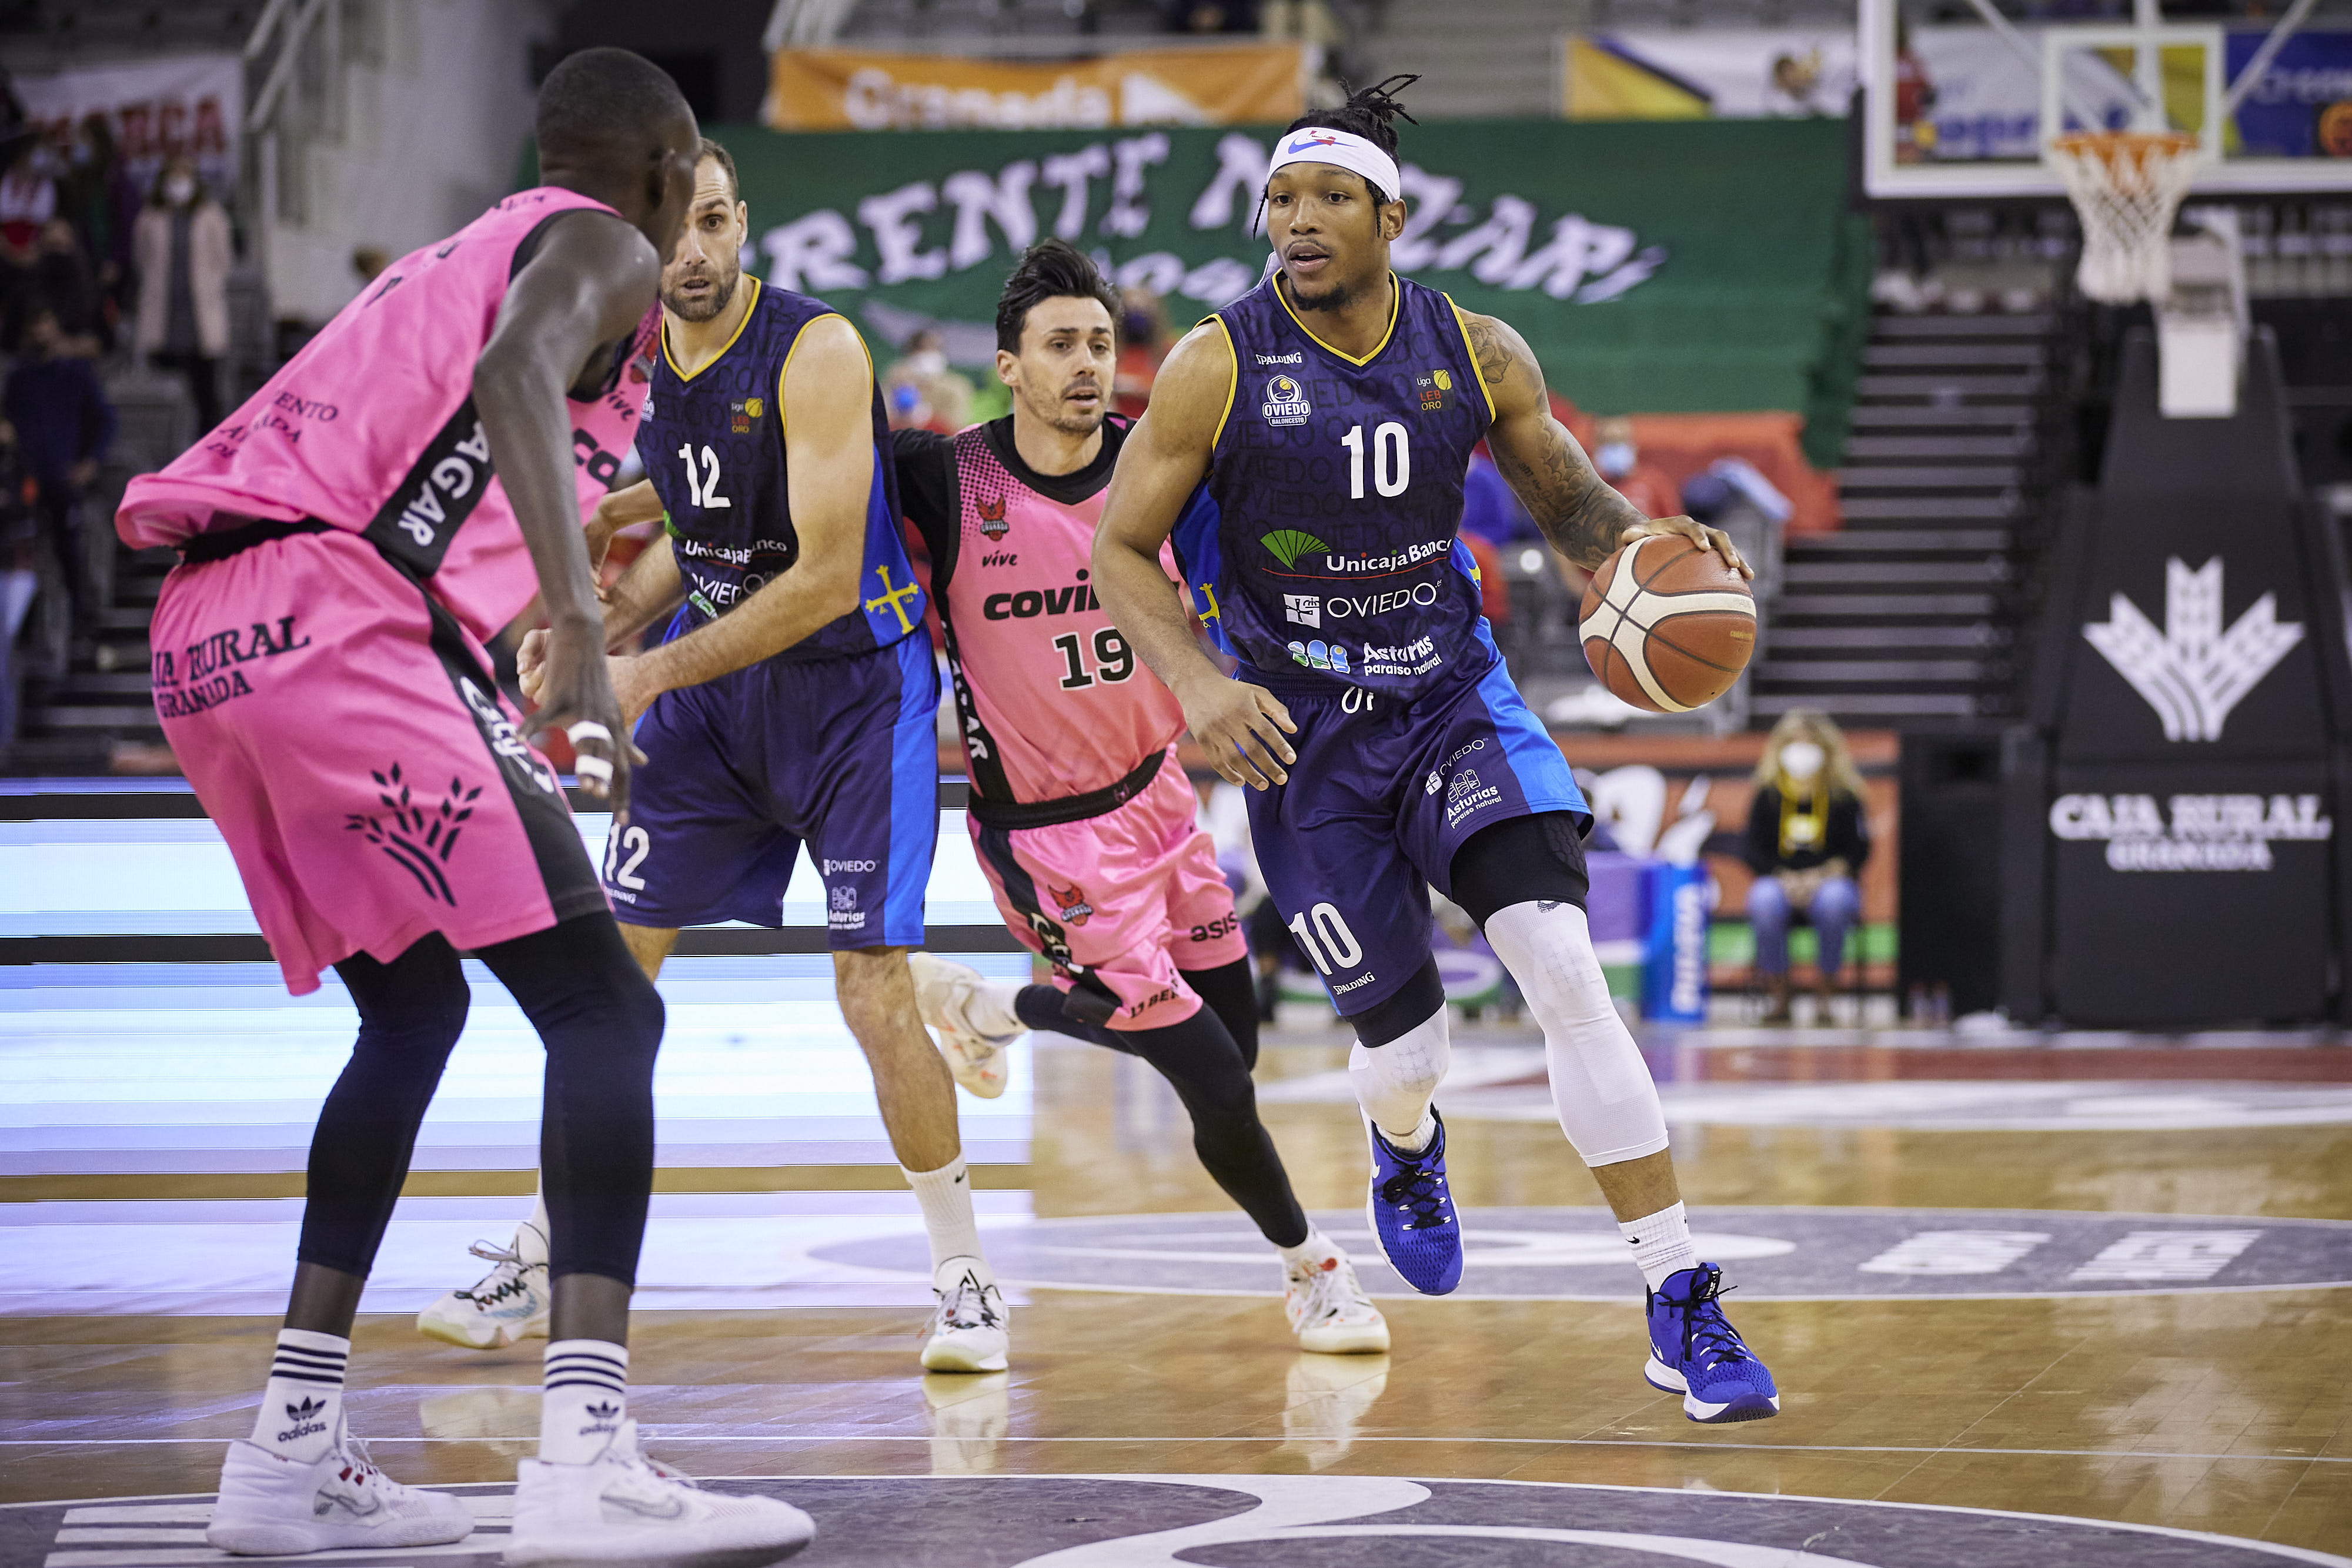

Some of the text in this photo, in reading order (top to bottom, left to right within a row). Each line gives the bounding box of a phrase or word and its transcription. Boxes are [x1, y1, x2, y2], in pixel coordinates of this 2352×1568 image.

[740, 132, 1171, 294] RENTE
[1255, 352, 1302, 365] SPALDING
[1264, 402, 1309, 417] OVIEDO
[1420, 389, 1442, 402] LEB
[1421, 400, 1442, 411] ORO
[1271, 416, 1305, 425] BALONCESTO
[678, 442, 731, 509] 12
[1341, 421, 1410, 499] 10
[186, 614, 312, 681] RURAL
[1051, 626, 1136, 692] 19
[1363, 635, 1434, 664] Asturias
[1364, 653, 1443, 677] paraiso natural
[1447, 785, 1499, 821] Asturias
[1450, 795, 1502, 830] paraiso natural
[605, 821, 650, 891] 12
[1288, 902, 1363, 976] 10
[1332, 971, 1376, 996] SPALDING
[278, 1421, 327, 1442] adidas
